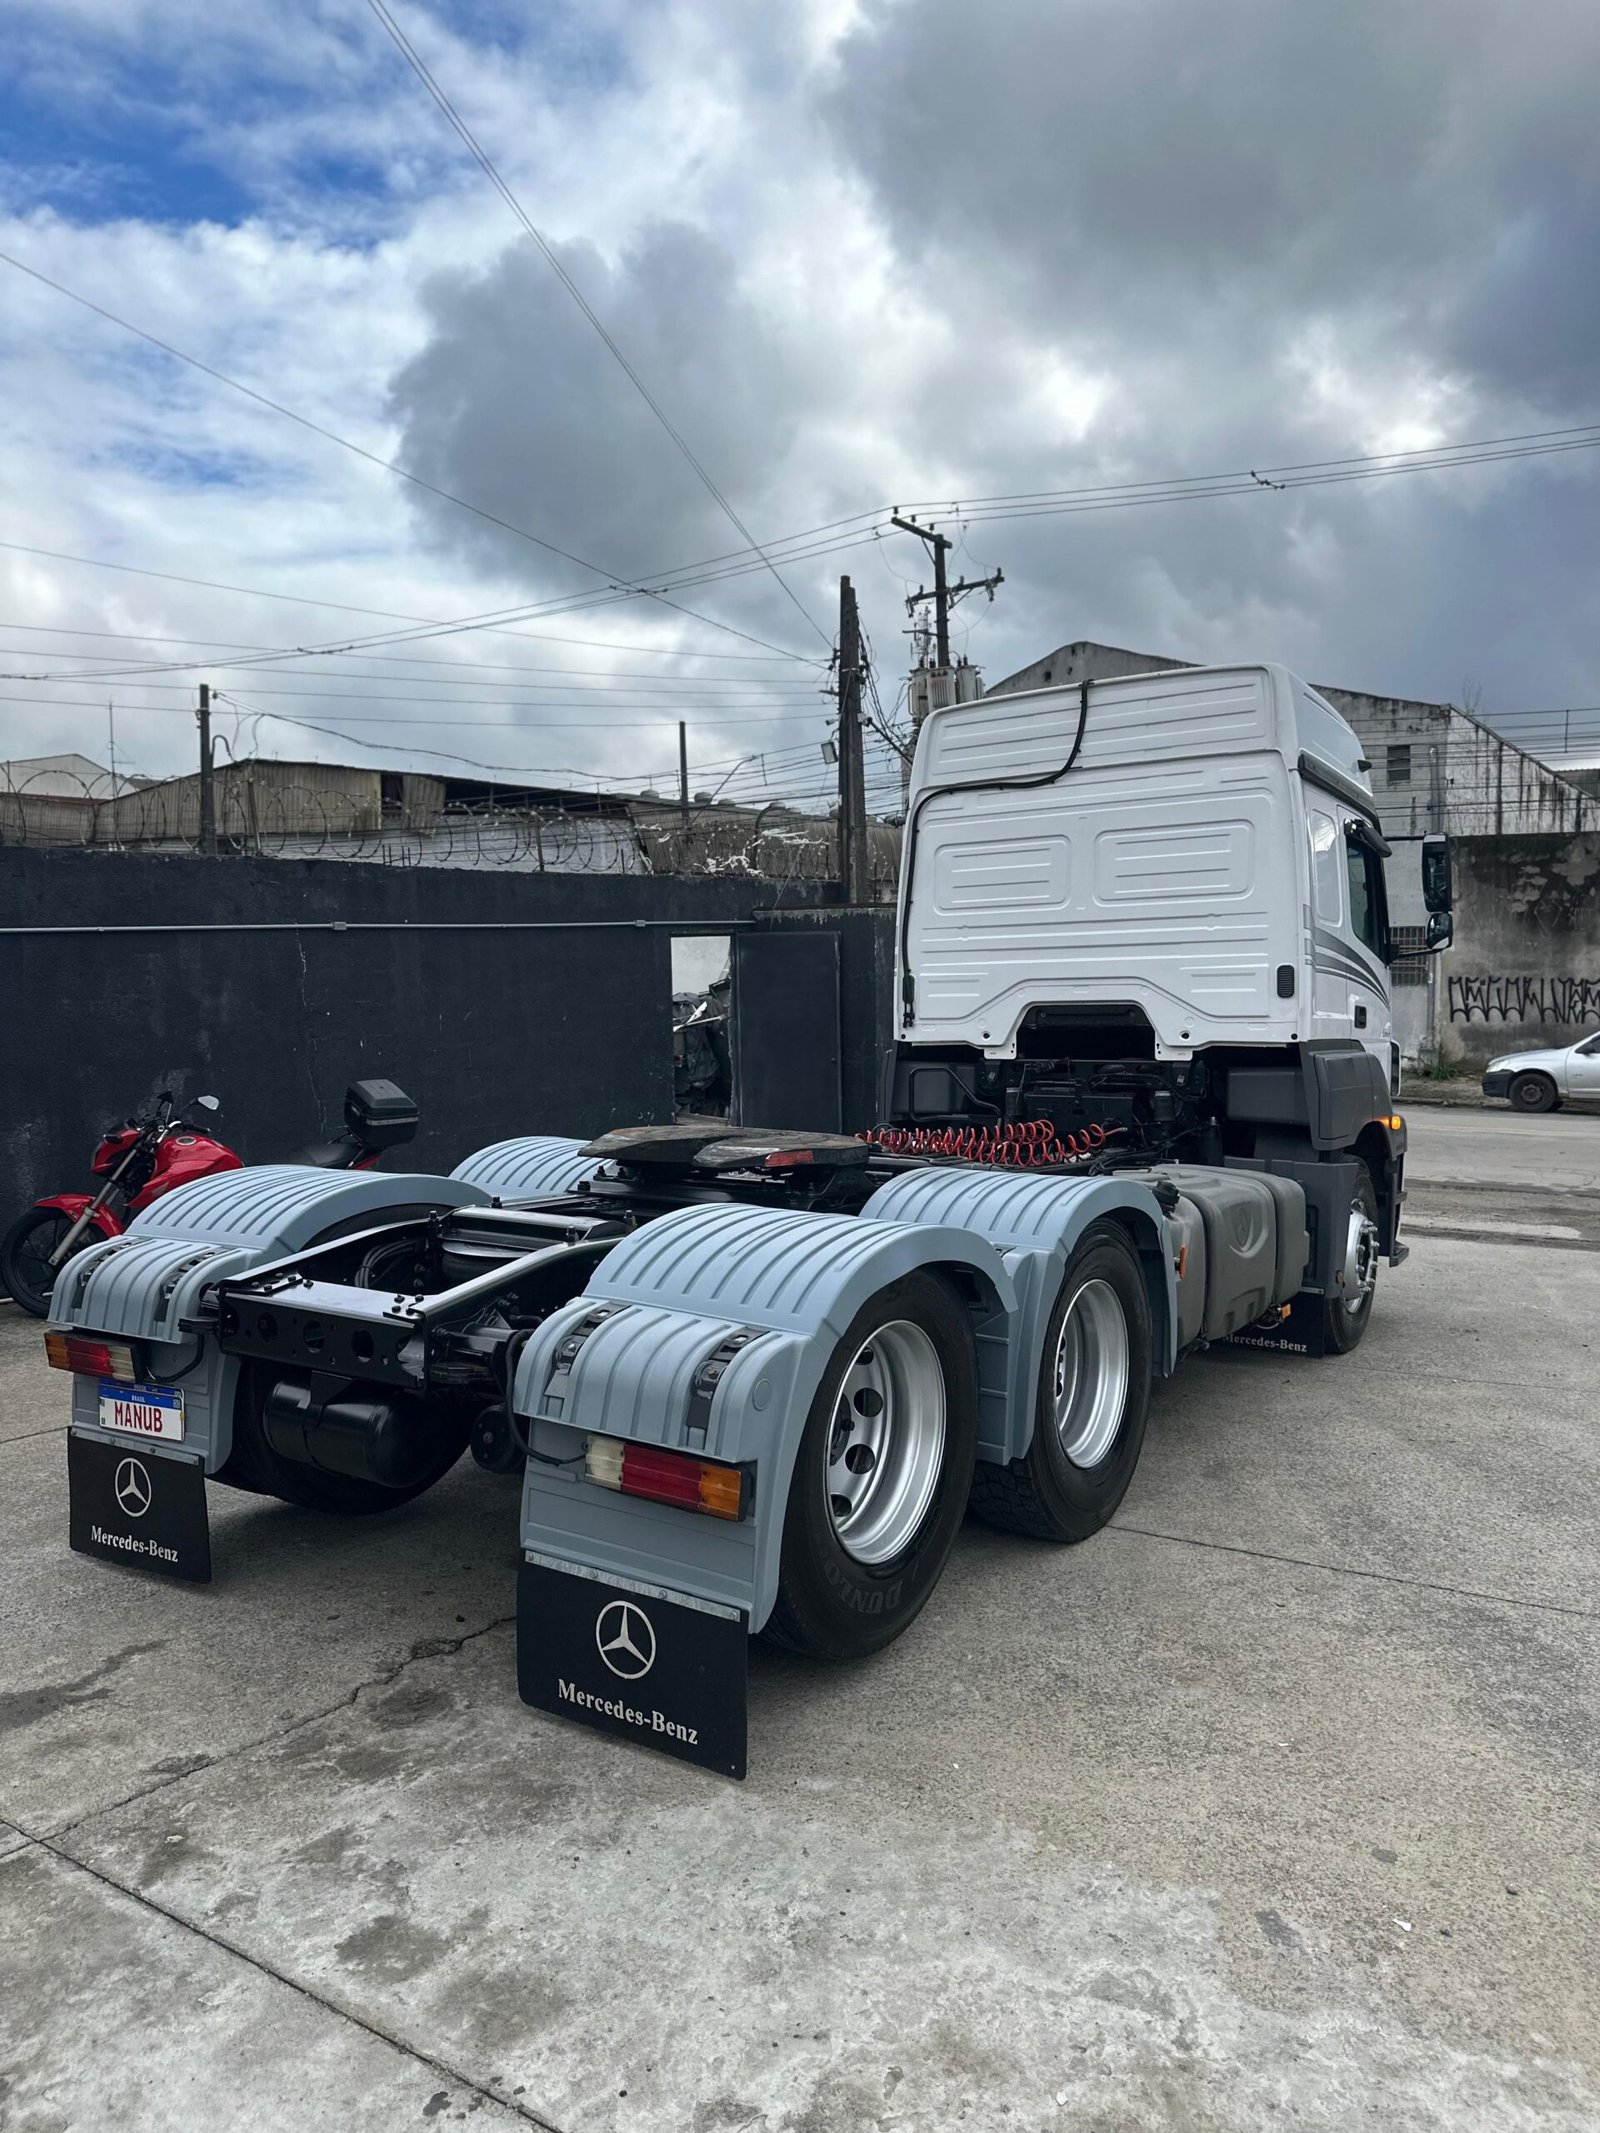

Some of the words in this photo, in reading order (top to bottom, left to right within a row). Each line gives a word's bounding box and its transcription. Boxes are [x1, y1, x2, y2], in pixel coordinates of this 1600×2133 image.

[1222, 1333, 1308, 1353] Mercedes-Benz
[114, 1401, 163, 1433] MANUB
[91, 1525, 179, 1563] Mercedes-Benz
[557, 1678, 699, 1746] Mercedes-Benz
